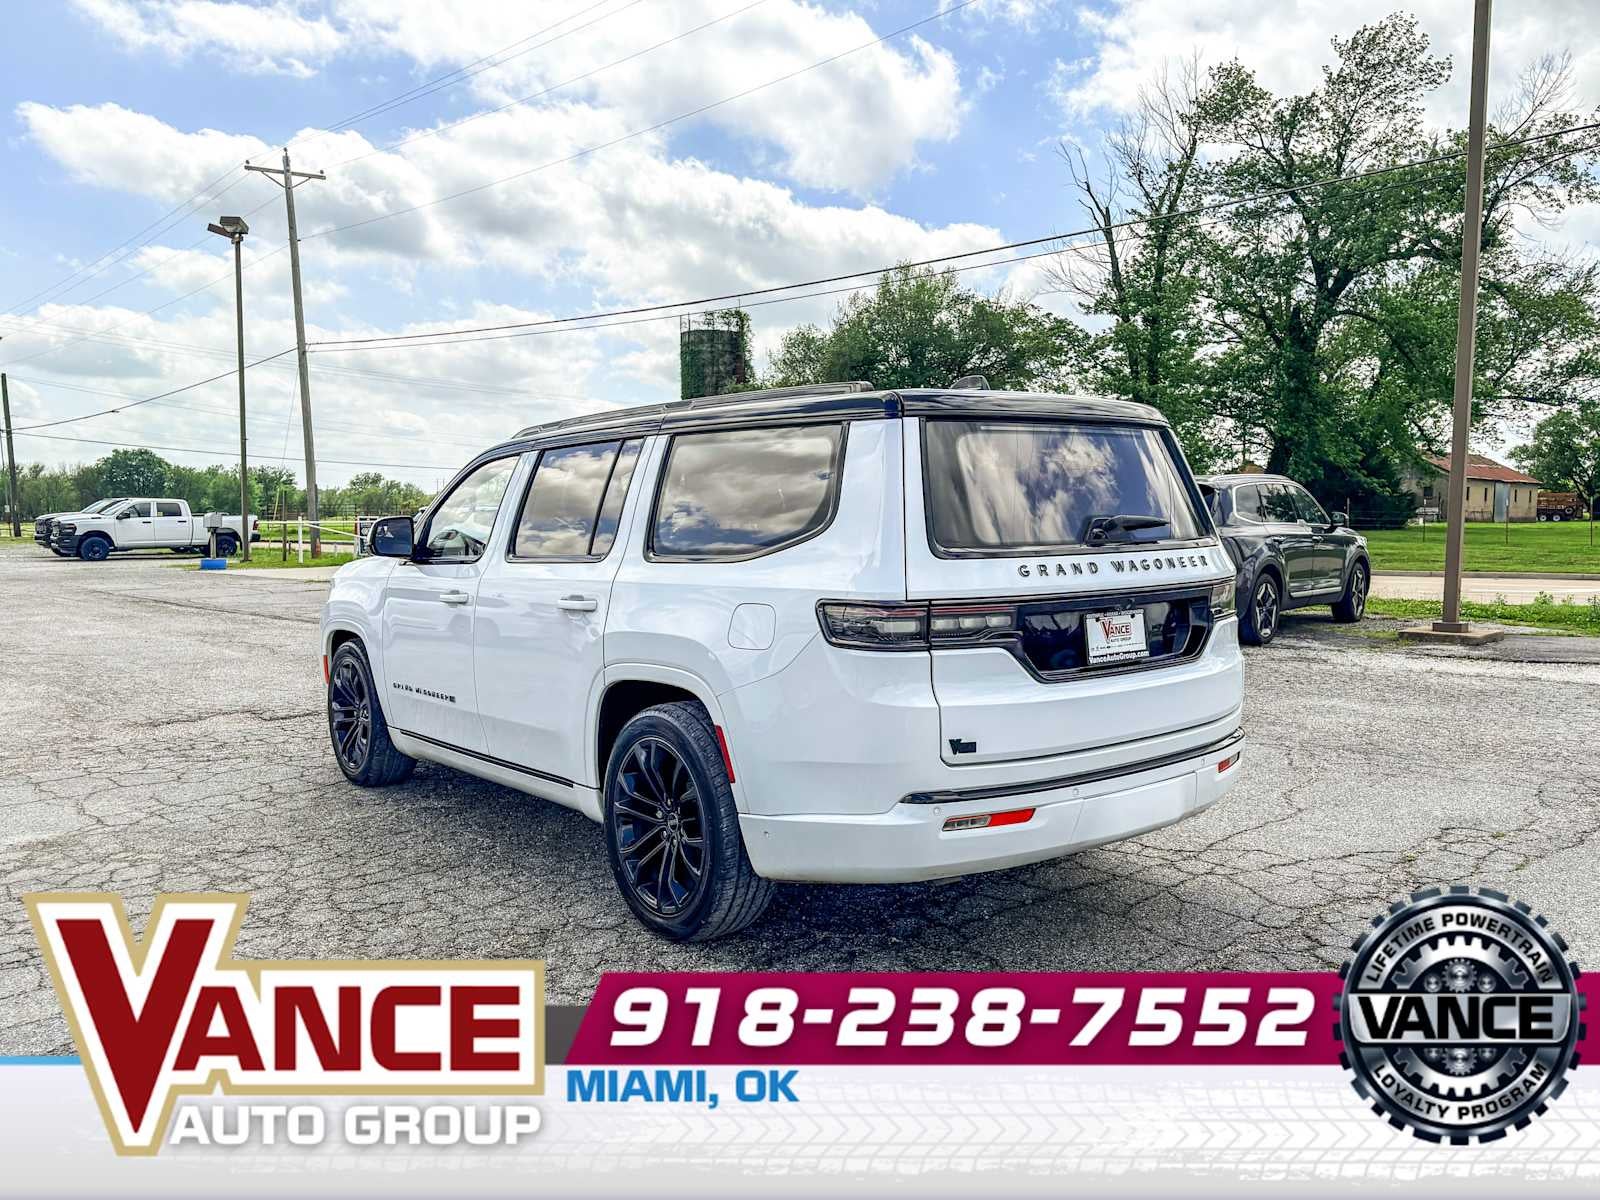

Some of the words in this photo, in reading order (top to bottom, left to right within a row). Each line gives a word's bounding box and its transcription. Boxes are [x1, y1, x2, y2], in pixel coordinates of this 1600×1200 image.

[1018, 562, 1099, 578] GRAND
[1111, 555, 1208, 573] WAGONEER
[1089, 651, 1149, 664] VanceAutoGroup.com
